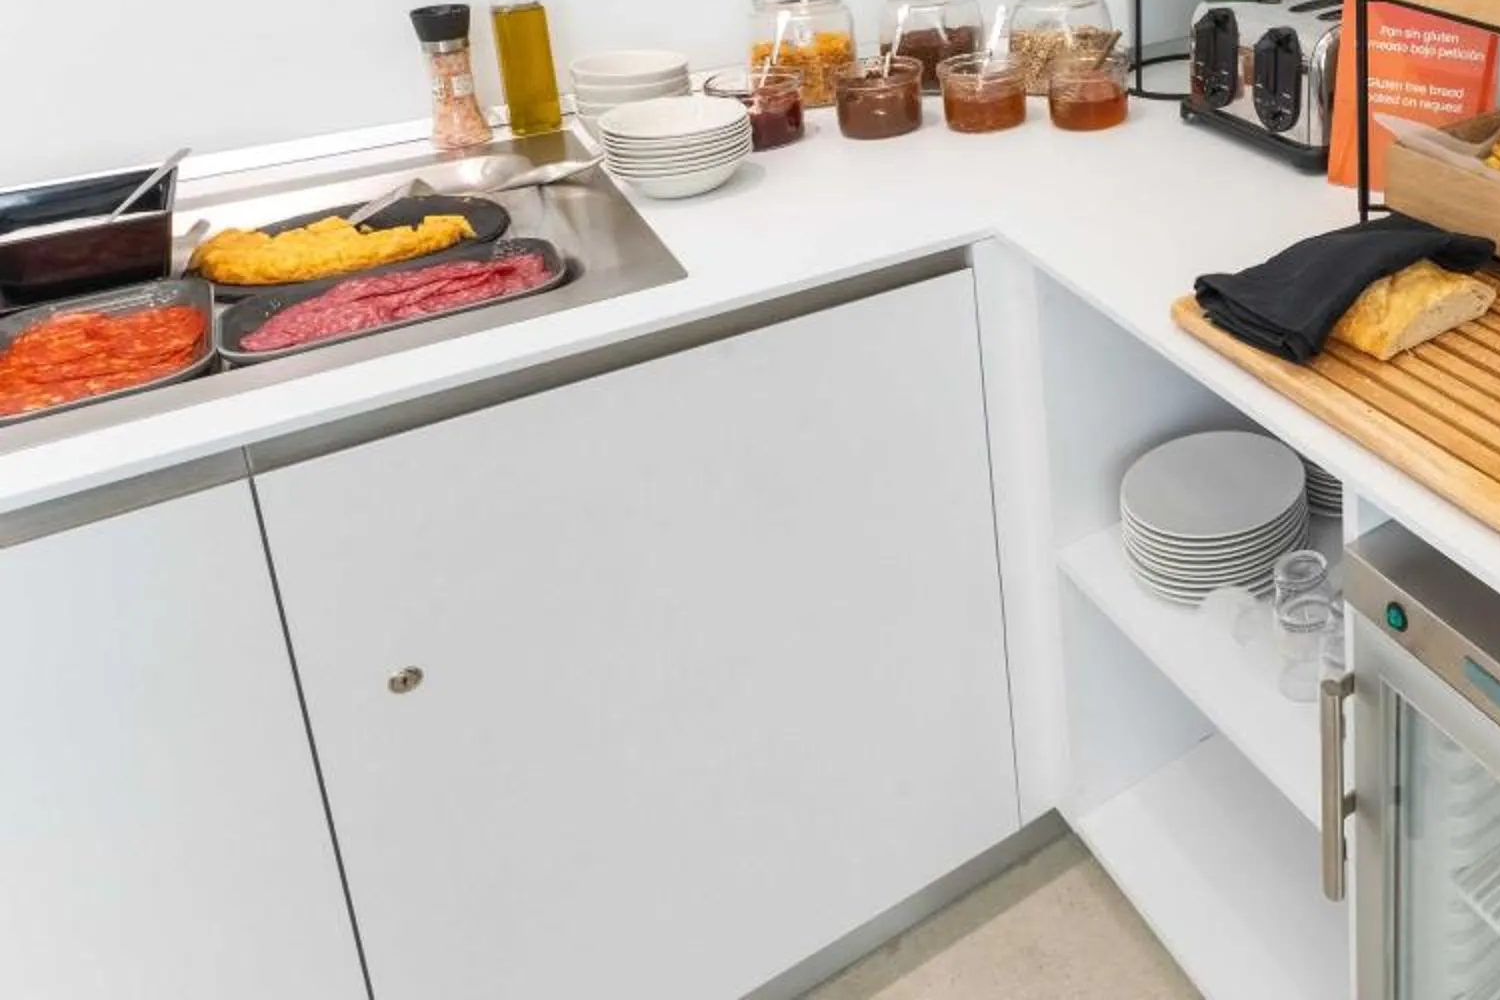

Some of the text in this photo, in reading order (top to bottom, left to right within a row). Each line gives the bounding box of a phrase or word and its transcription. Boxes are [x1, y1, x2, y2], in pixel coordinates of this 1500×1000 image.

[1404, 28, 1421, 40] sin
[1423, 30, 1459, 44] gluten
[1411, 43, 1436, 58] bajo
[1437, 47, 1486, 62] petición
[1404, 81, 1427, 93] free
[1429, 85, 1464, 99] bread
[1402, 96, 1418, 108] on
[1420, 100, 1463, 114] request
